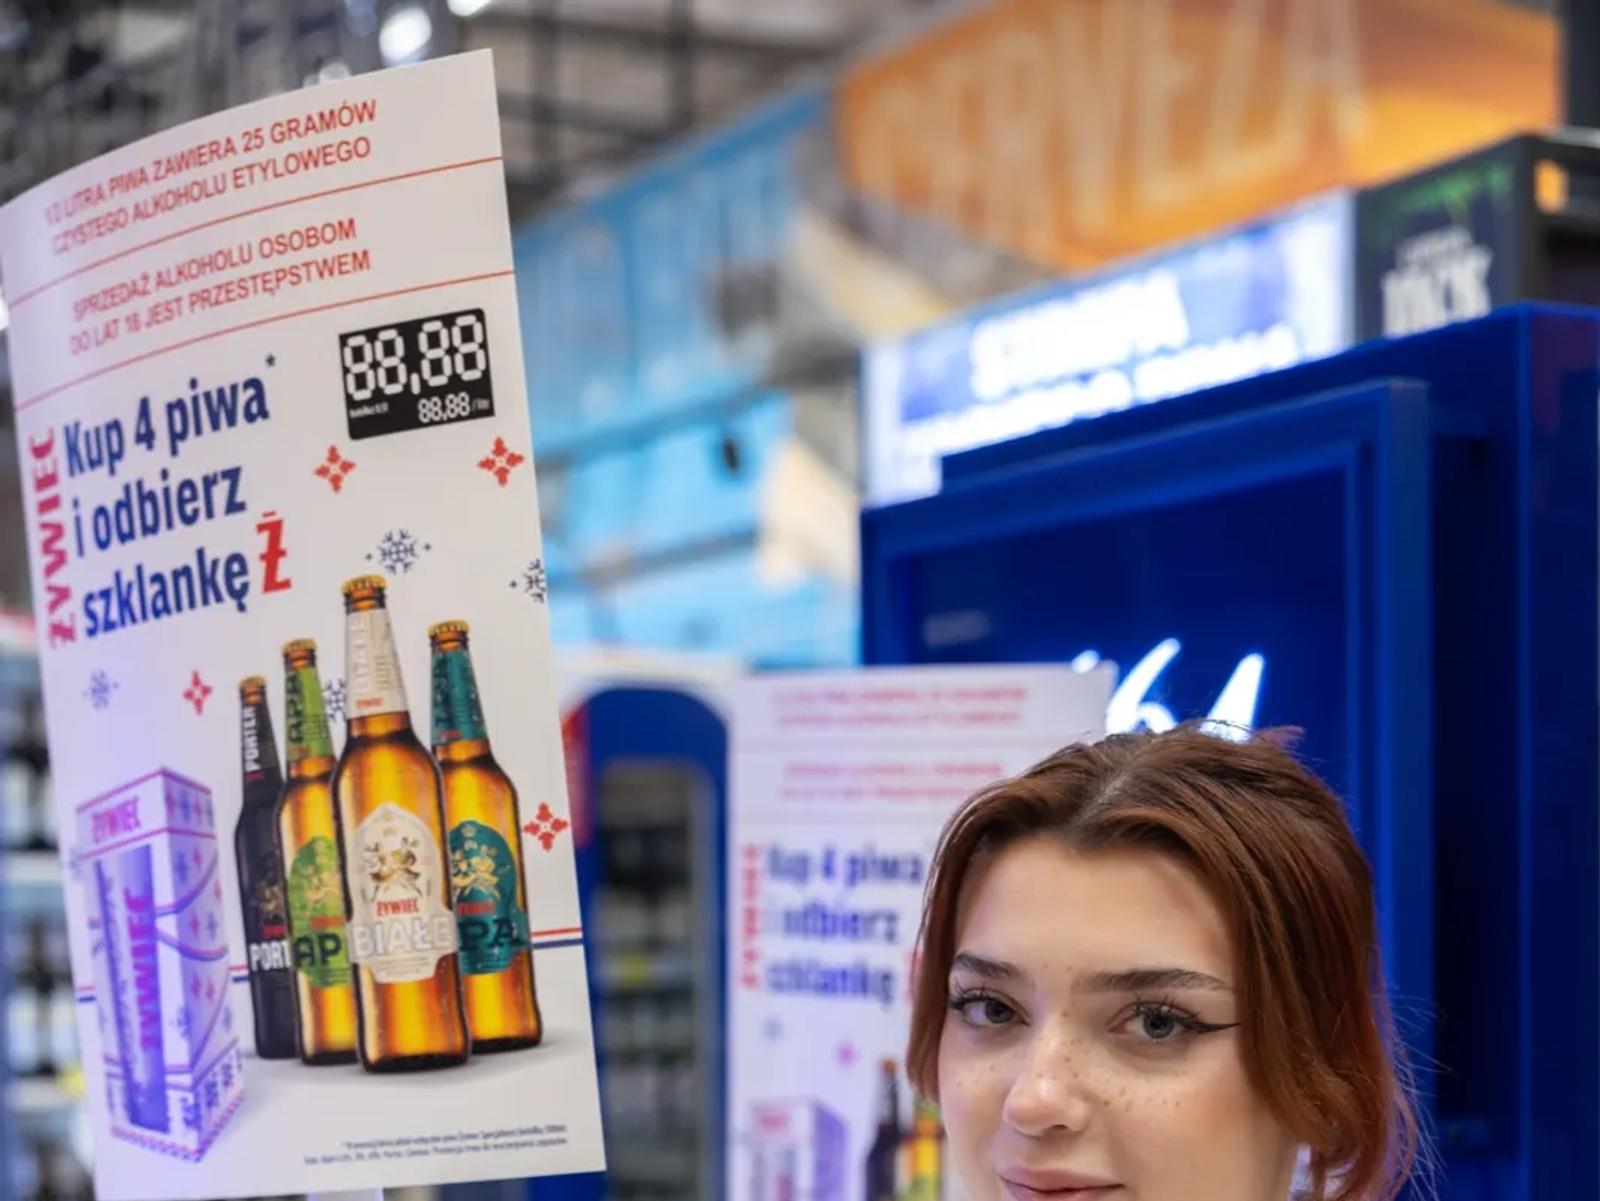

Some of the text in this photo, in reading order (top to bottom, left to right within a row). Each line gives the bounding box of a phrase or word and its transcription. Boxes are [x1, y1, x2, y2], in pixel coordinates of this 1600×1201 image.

[109, 166, 149, 198] PIWA
[153, 137, 237, 182] ZAWIERA
[242, 127, 265, 152] 25
[270, 99, 377, 144] GRAMÓW
[134, 173, 226, 221] ALKOHOLU
[233, 136, 371, 189] ETYLOWEGO
[74, 218, 357, 322] SPRZEDAŻ ALKOHOLU OSOBOM
[94, 317, 120, 347] LAT
[145, 297, 183, 328] JEST
[188, 249, 371, 314] PRZESTĘPSTWEM
[64, 419, 125, 478] Kup
[134, 396, 155, 451] 4
[73, 466, 247, 558] i odbierz
[84, 547, 250, 638] szklankę
[249, 940, 292, 972] PORT
[294, 932, 342, 968] AP
[353, 916, 450, 958] BIAŁE
[458, 917, 528, 951] PA
